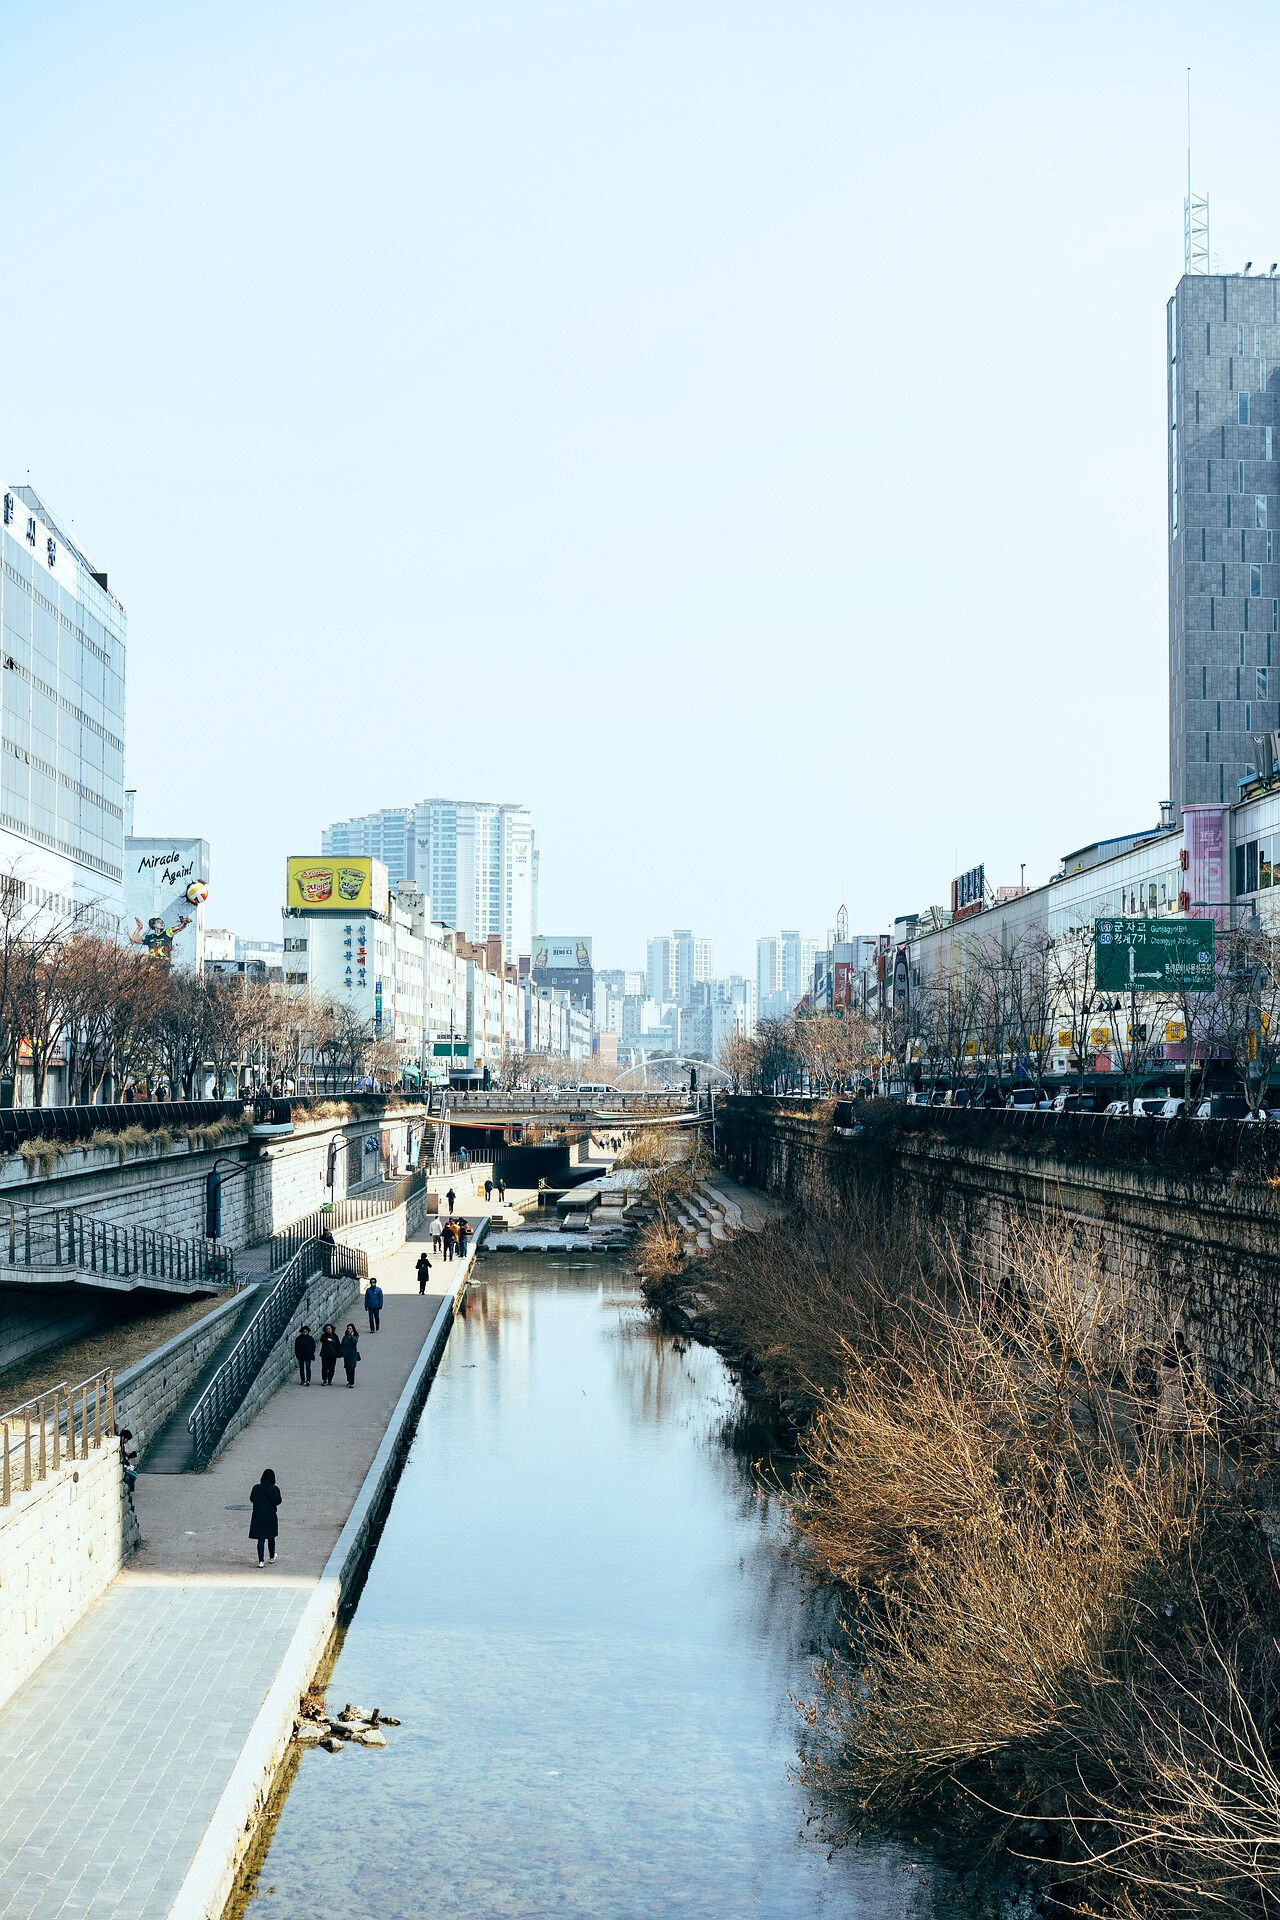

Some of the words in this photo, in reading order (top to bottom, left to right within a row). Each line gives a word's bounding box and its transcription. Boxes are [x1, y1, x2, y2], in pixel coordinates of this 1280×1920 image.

[138, 851, 180, 873] Miracle
[161, 861, 194, 885] Again!
[1114, 921, 1147, 932] 군자교
[1114, 933, 1147, 945] 청계7가
[357, 924, 368, 989] 신발도매상가
